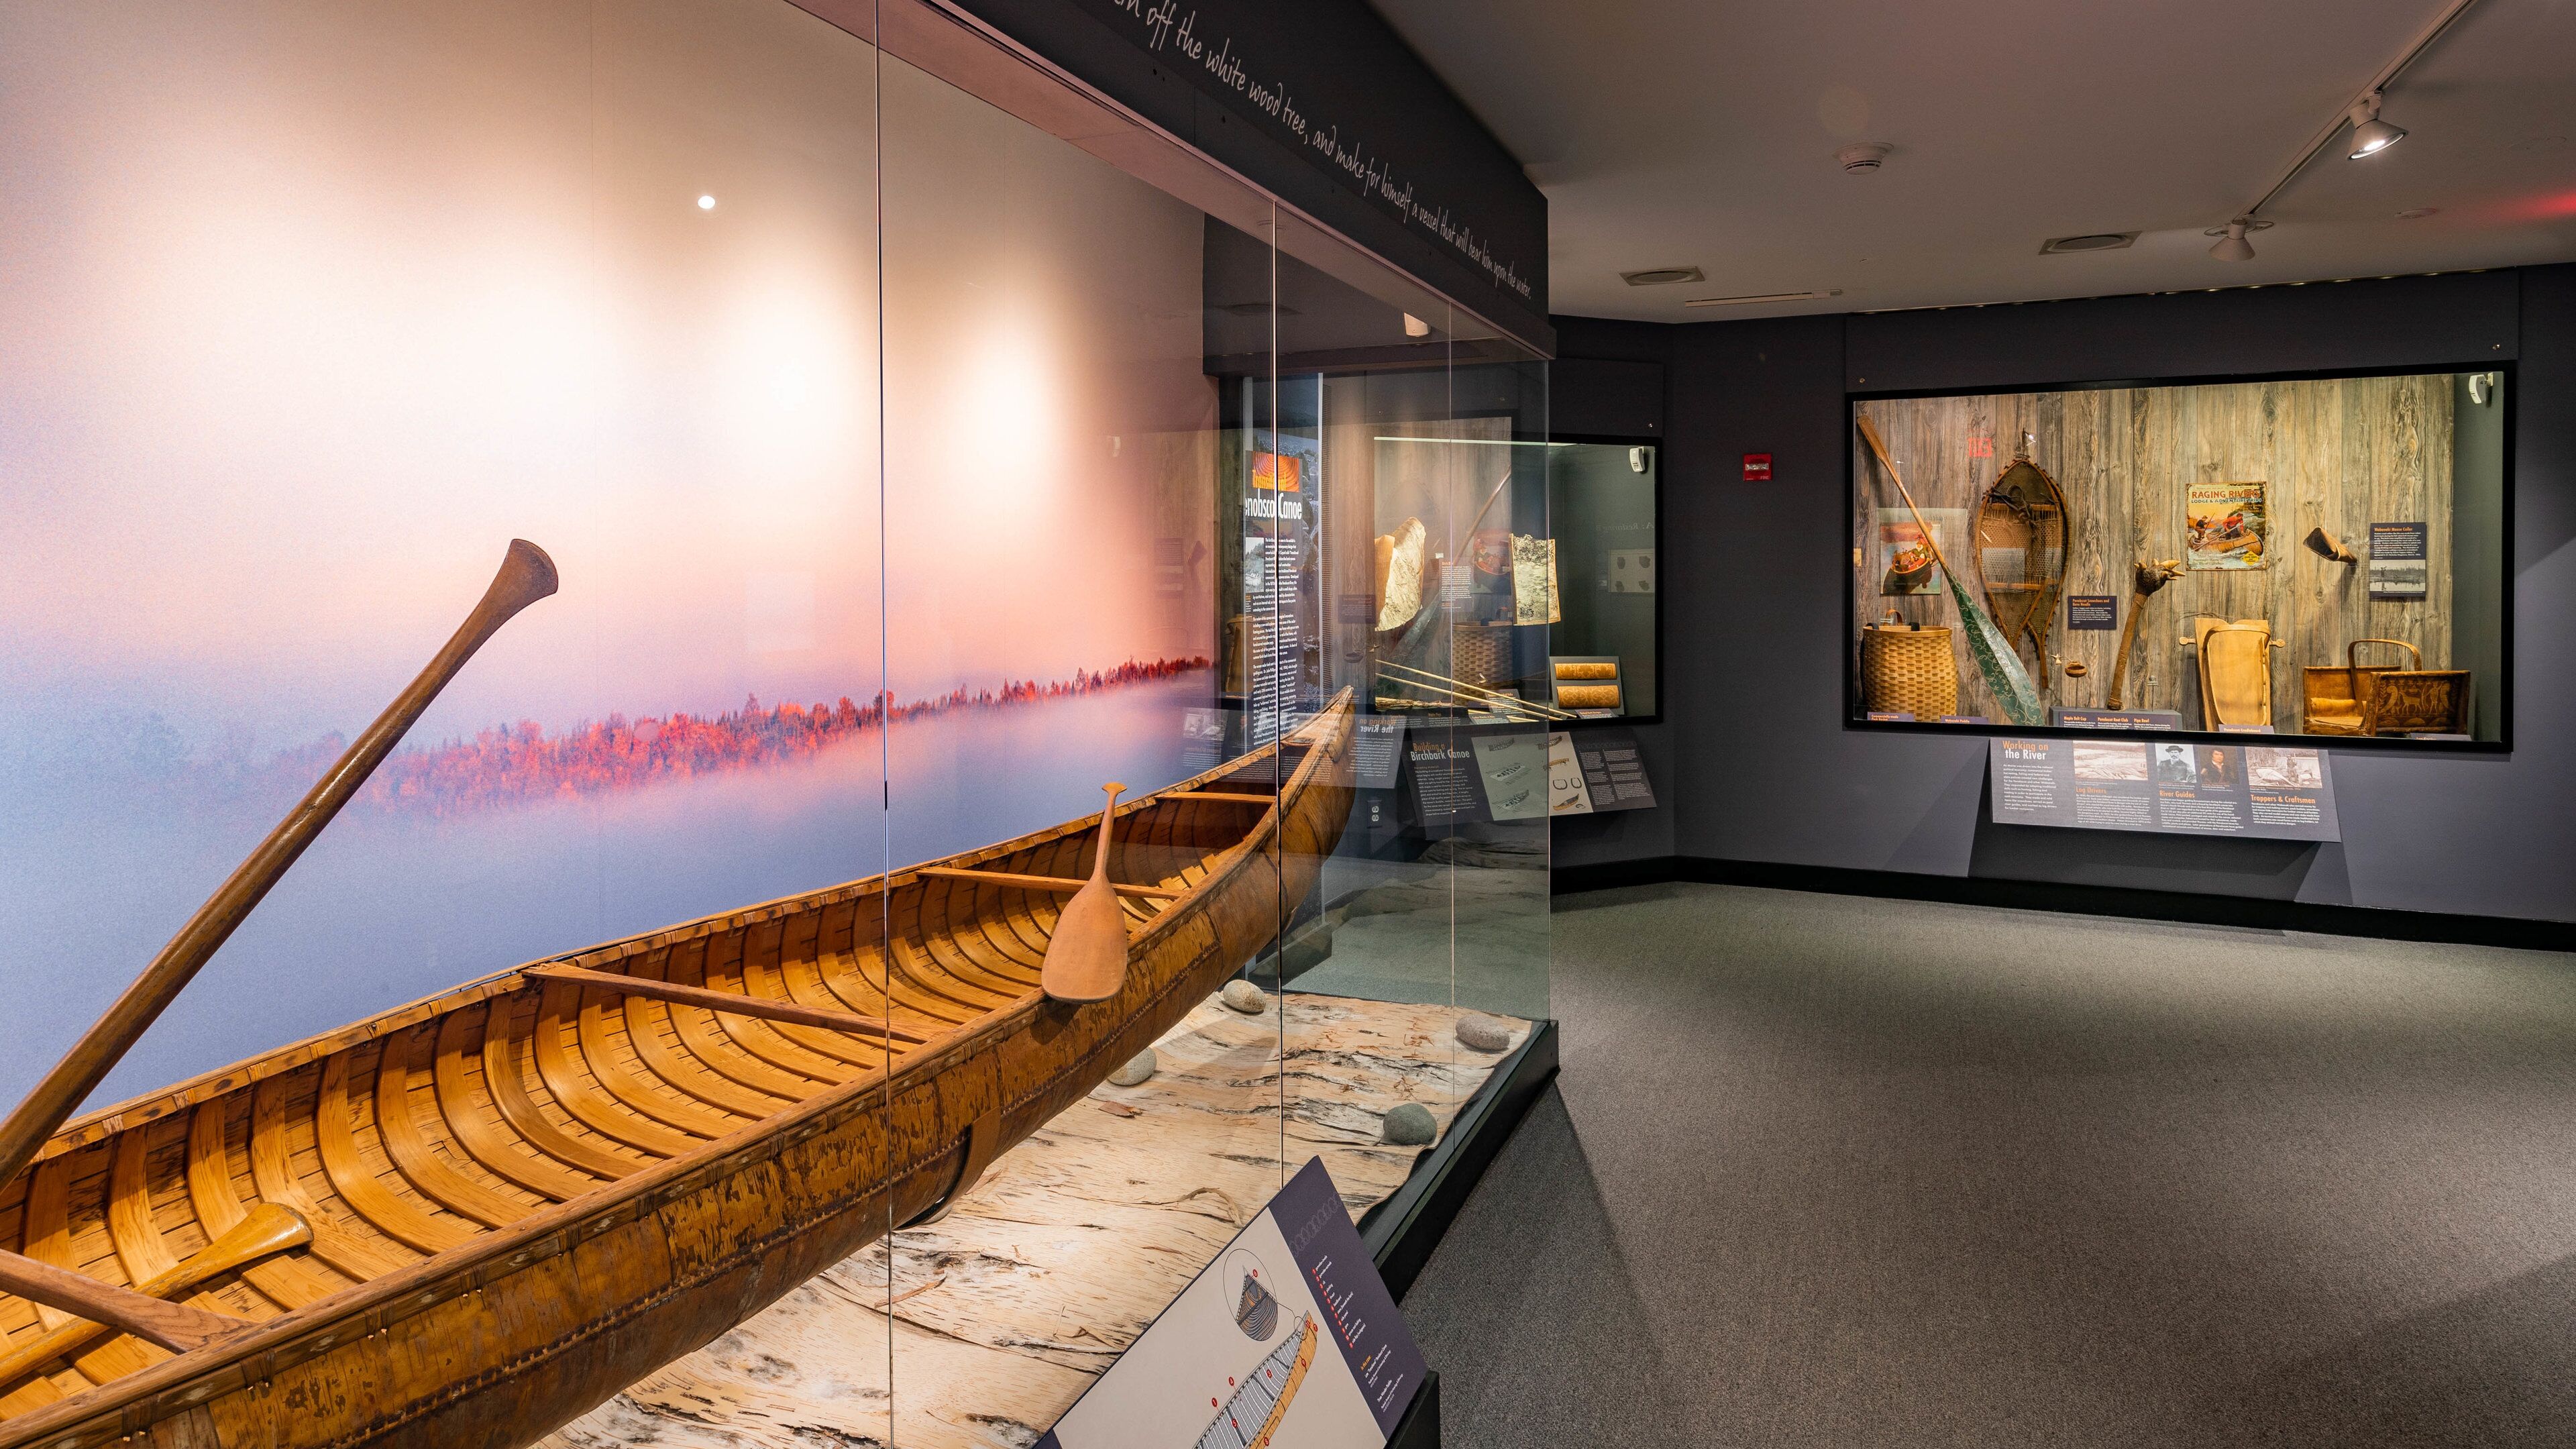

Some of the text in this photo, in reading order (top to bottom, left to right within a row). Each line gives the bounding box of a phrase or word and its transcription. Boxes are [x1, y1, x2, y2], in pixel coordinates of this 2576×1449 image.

[1146, 0, 1176, 51] off
[1177, 10, 1201, 59] the
[1205, 38, 1246, 91] white
[1249, 81, 1283, 115] wood
[1283, 97, 1308, 144] tree,
[1313, 125, 1336, 156] and
[1336, 142, 1364, 178] make
[1364, 157, 1380, 196] for
[1381, 162, 1413, 223] himself
[1411, 203, 1417, 217] a
[1419, 206, 1441, 232] vessel
[1440, 210, 1456, 243] that
[1456, 227, 1469, 253] will
[1468, 235, 1482, 262] bear
[1482, 239, 1493, 272] him
[1493, 262, 1507, 288] upon
[1507, 260, 1516, 287] the
[1516, 278, 1532, 300] water.
[1252, 470, 1287, 490] Transitinal
[2192, 489, 2261, 499] RAGING RIVERS
[1278, 493, 1301, 519] Canoe
[1413, 741, 1440, 752] Building
[2002, 740, 2037, 751] Working
[1410, 749, 1470, 761] Birchbark Canoe
[2005, 748, 2046, 760] the River
[2251, 794, 2276, 802] Trappers
[2284, 796, 2316, 804] Craftsmen
